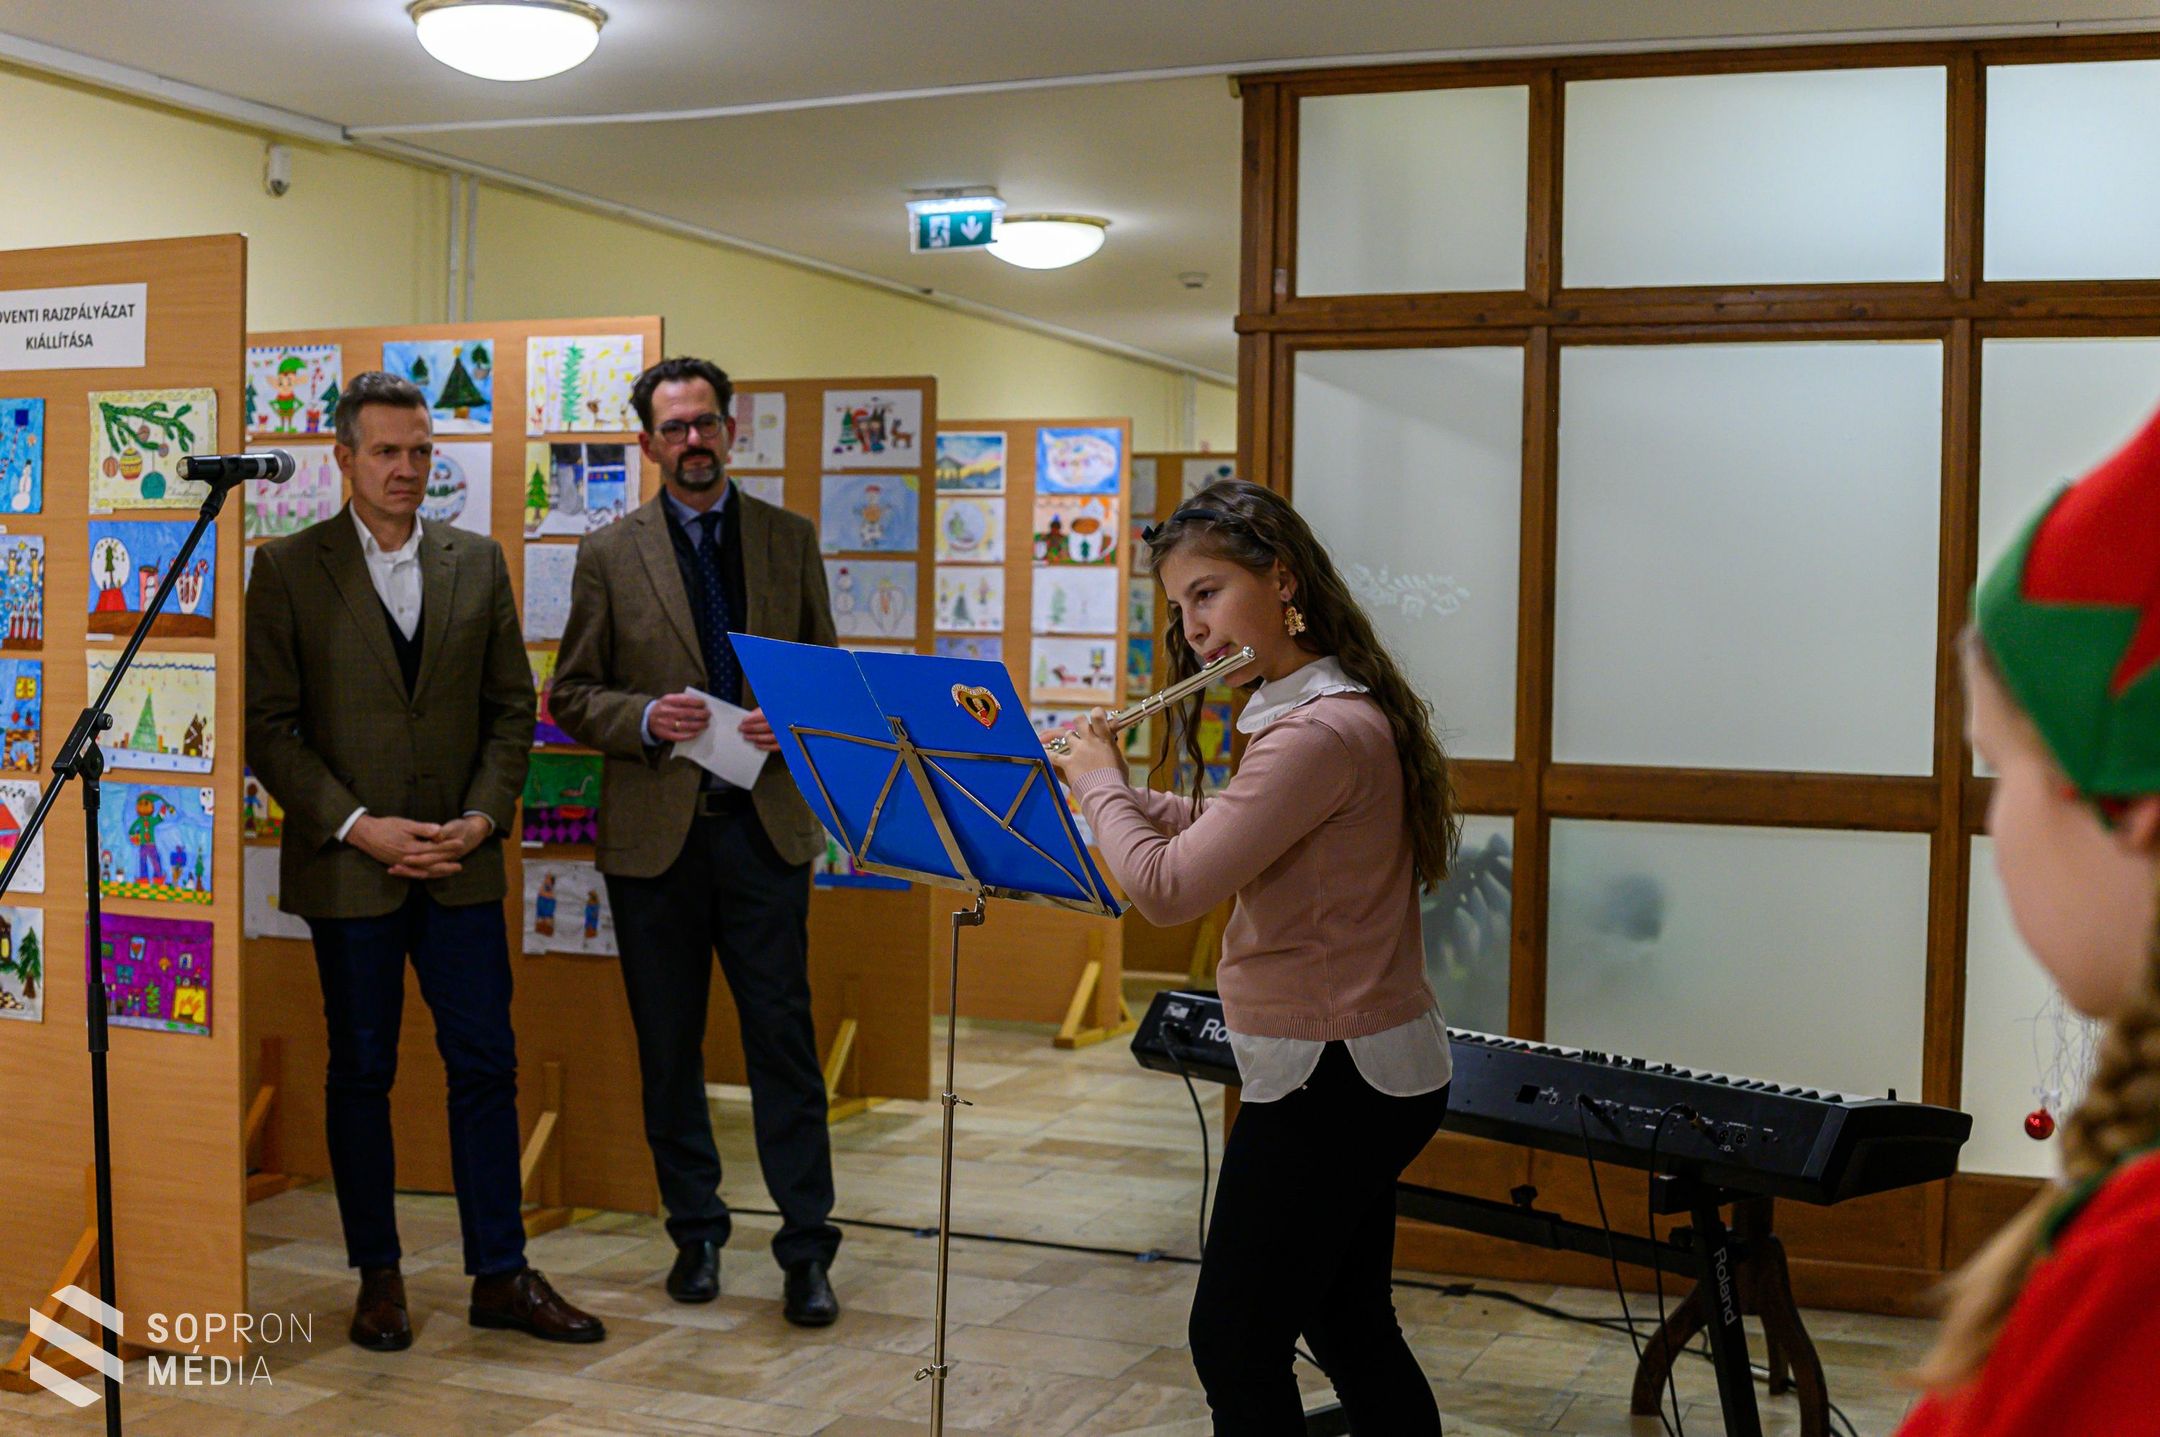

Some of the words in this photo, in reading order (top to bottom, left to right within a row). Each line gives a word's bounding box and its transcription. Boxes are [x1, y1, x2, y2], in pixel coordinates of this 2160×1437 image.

[42, 301, 136, 323] RAJZPÁLYÁZAT
[26, 331, 94, 350] KIÁLLÍTÁSA
[1199, 1018, 1231, 1043] Ro
[1713, 1246, 1738, 1326] Roland
